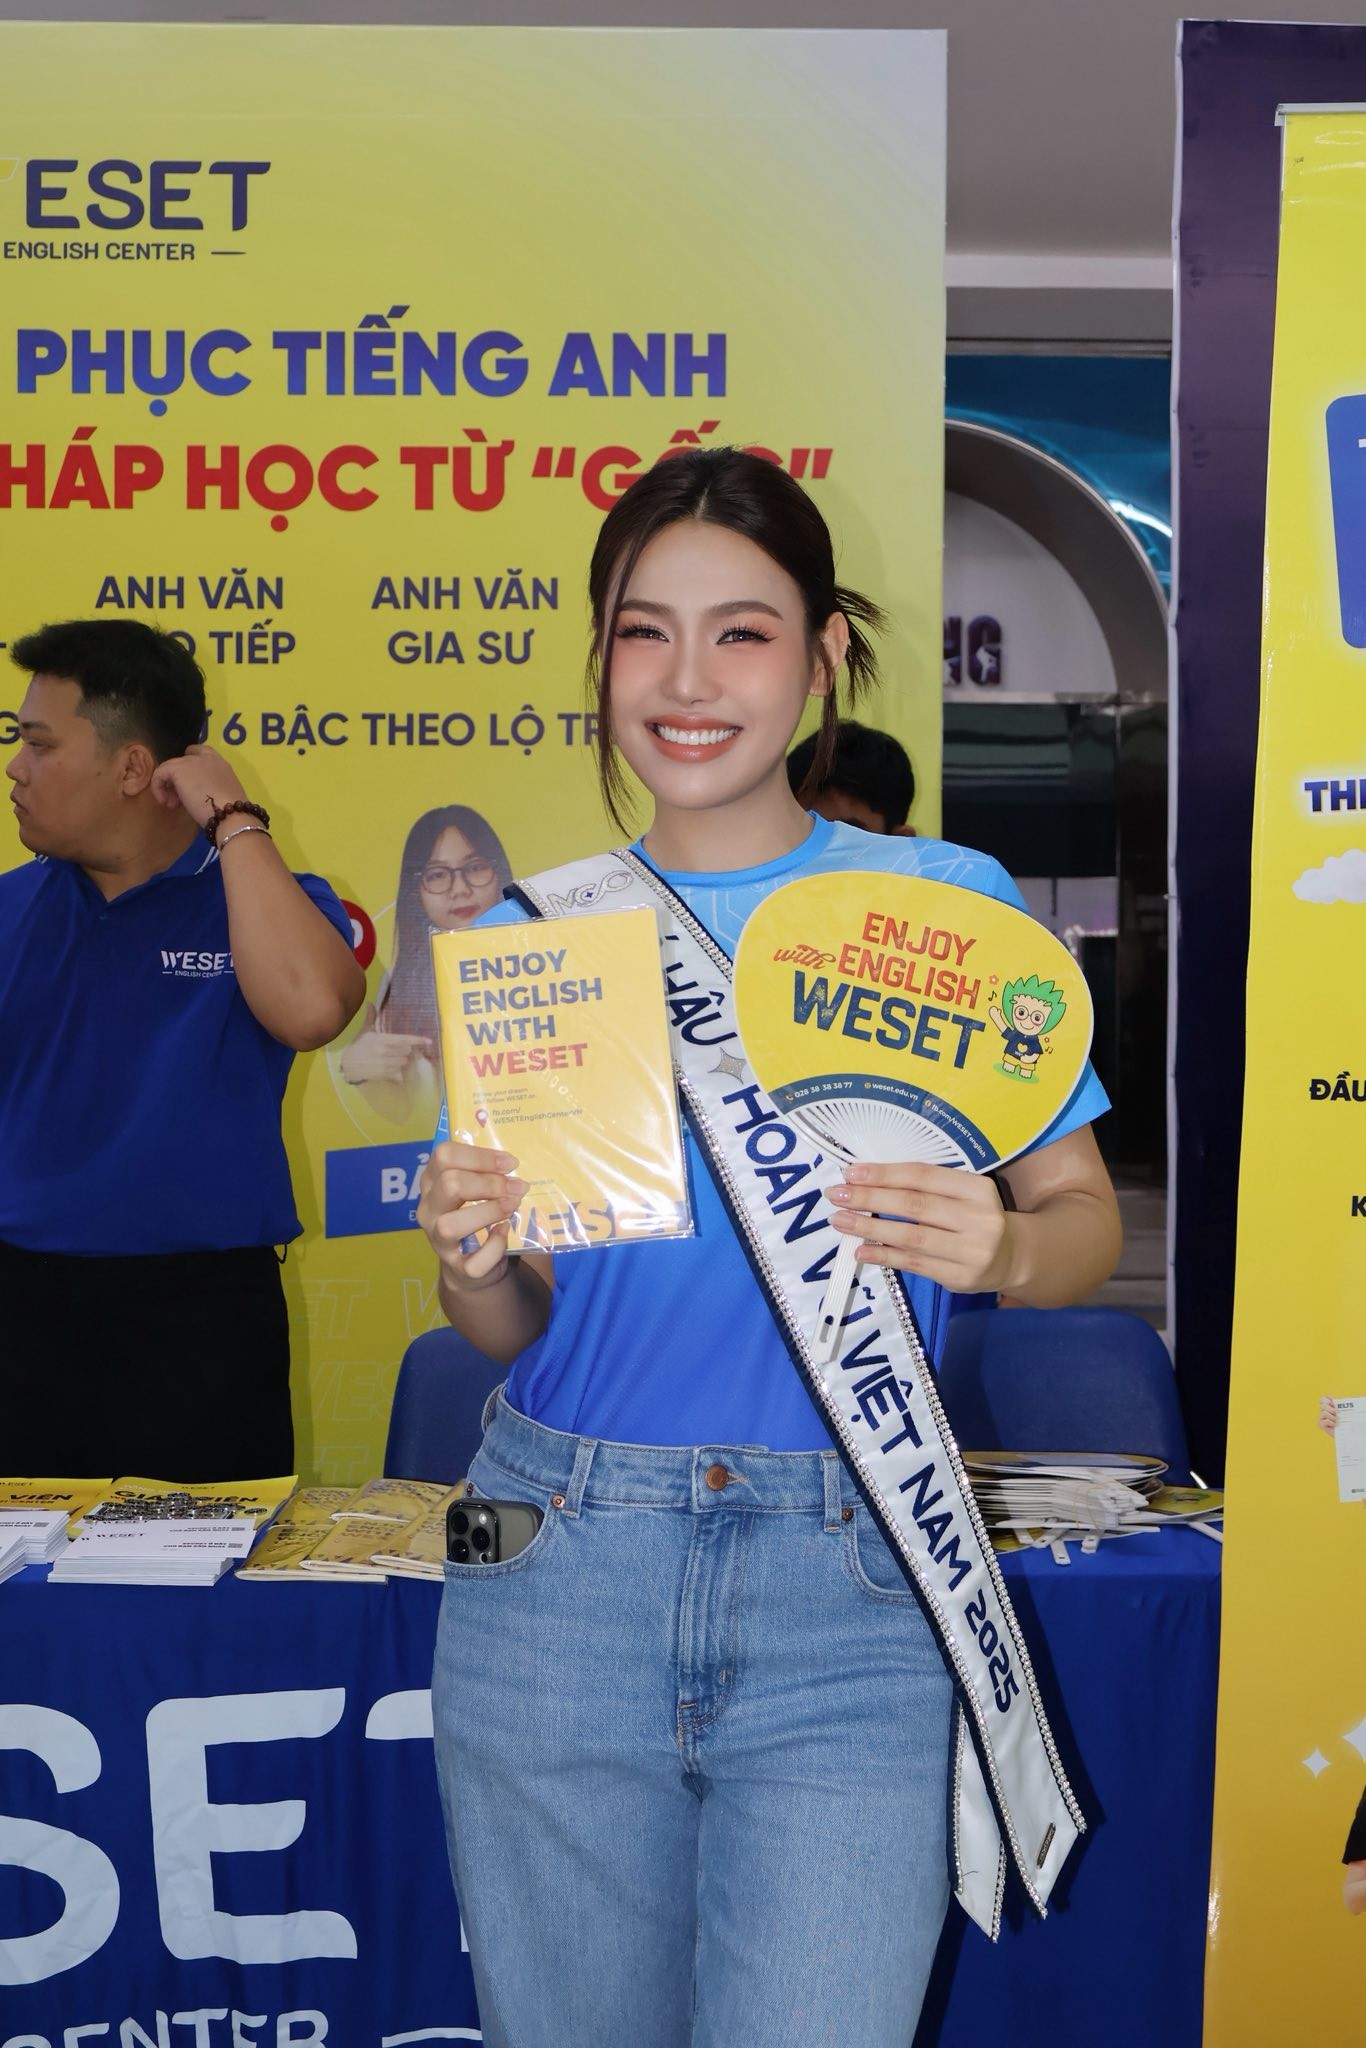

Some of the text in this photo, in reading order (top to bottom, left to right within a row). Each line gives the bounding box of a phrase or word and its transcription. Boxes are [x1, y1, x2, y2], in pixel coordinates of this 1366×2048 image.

[0, 158, 271, 231] ESET
[3, 241, 195, 260] ENGLISH CENTER
[17, 304, 727, 417] PHỤC TIẾNG ANH
[186, 444, 380, 533] HỌC
[400, 428, 515, 512] TỪ
[95, 568, 283, 610] ANH VĂN
[371, 568, 559, 610] ANH VĂN
[209, 618, 296, 664] TIẾP
[388, 628, 534, 665] GIA SƯ
[223, 712, 247, 745] 6
[261, 704, 349, 756] BẬC
[361, 712, 475, 746] THEO
[490, 704, 545, 756] LỘ
[862, 911, 976, 966] ENJOY
[459, 949, 567, 983] ENJOY
[773, 943, 981, 1009] with ENGLISH
[462, 977, 603, 1015] ENGLISH
[466, 1015, 556, 1046] WITH
[793, 970, 986, 1069] WESET
[470, 1043, 588, 1078] WESET
[794, 1089, 809, 1098] 028
[810, 1086, 820, 1094] 38
[843, 1081, 853, 1089] 77
[872, 1083, 919, 1101] weset.edu.vn
[722, 1084, 832, 1244] HOÀN
[840, 1329, 923, 1455] VIỆT
[899, 1462, 972, 1592] NAM
[964, 1589, 1020, 1713] 2025
